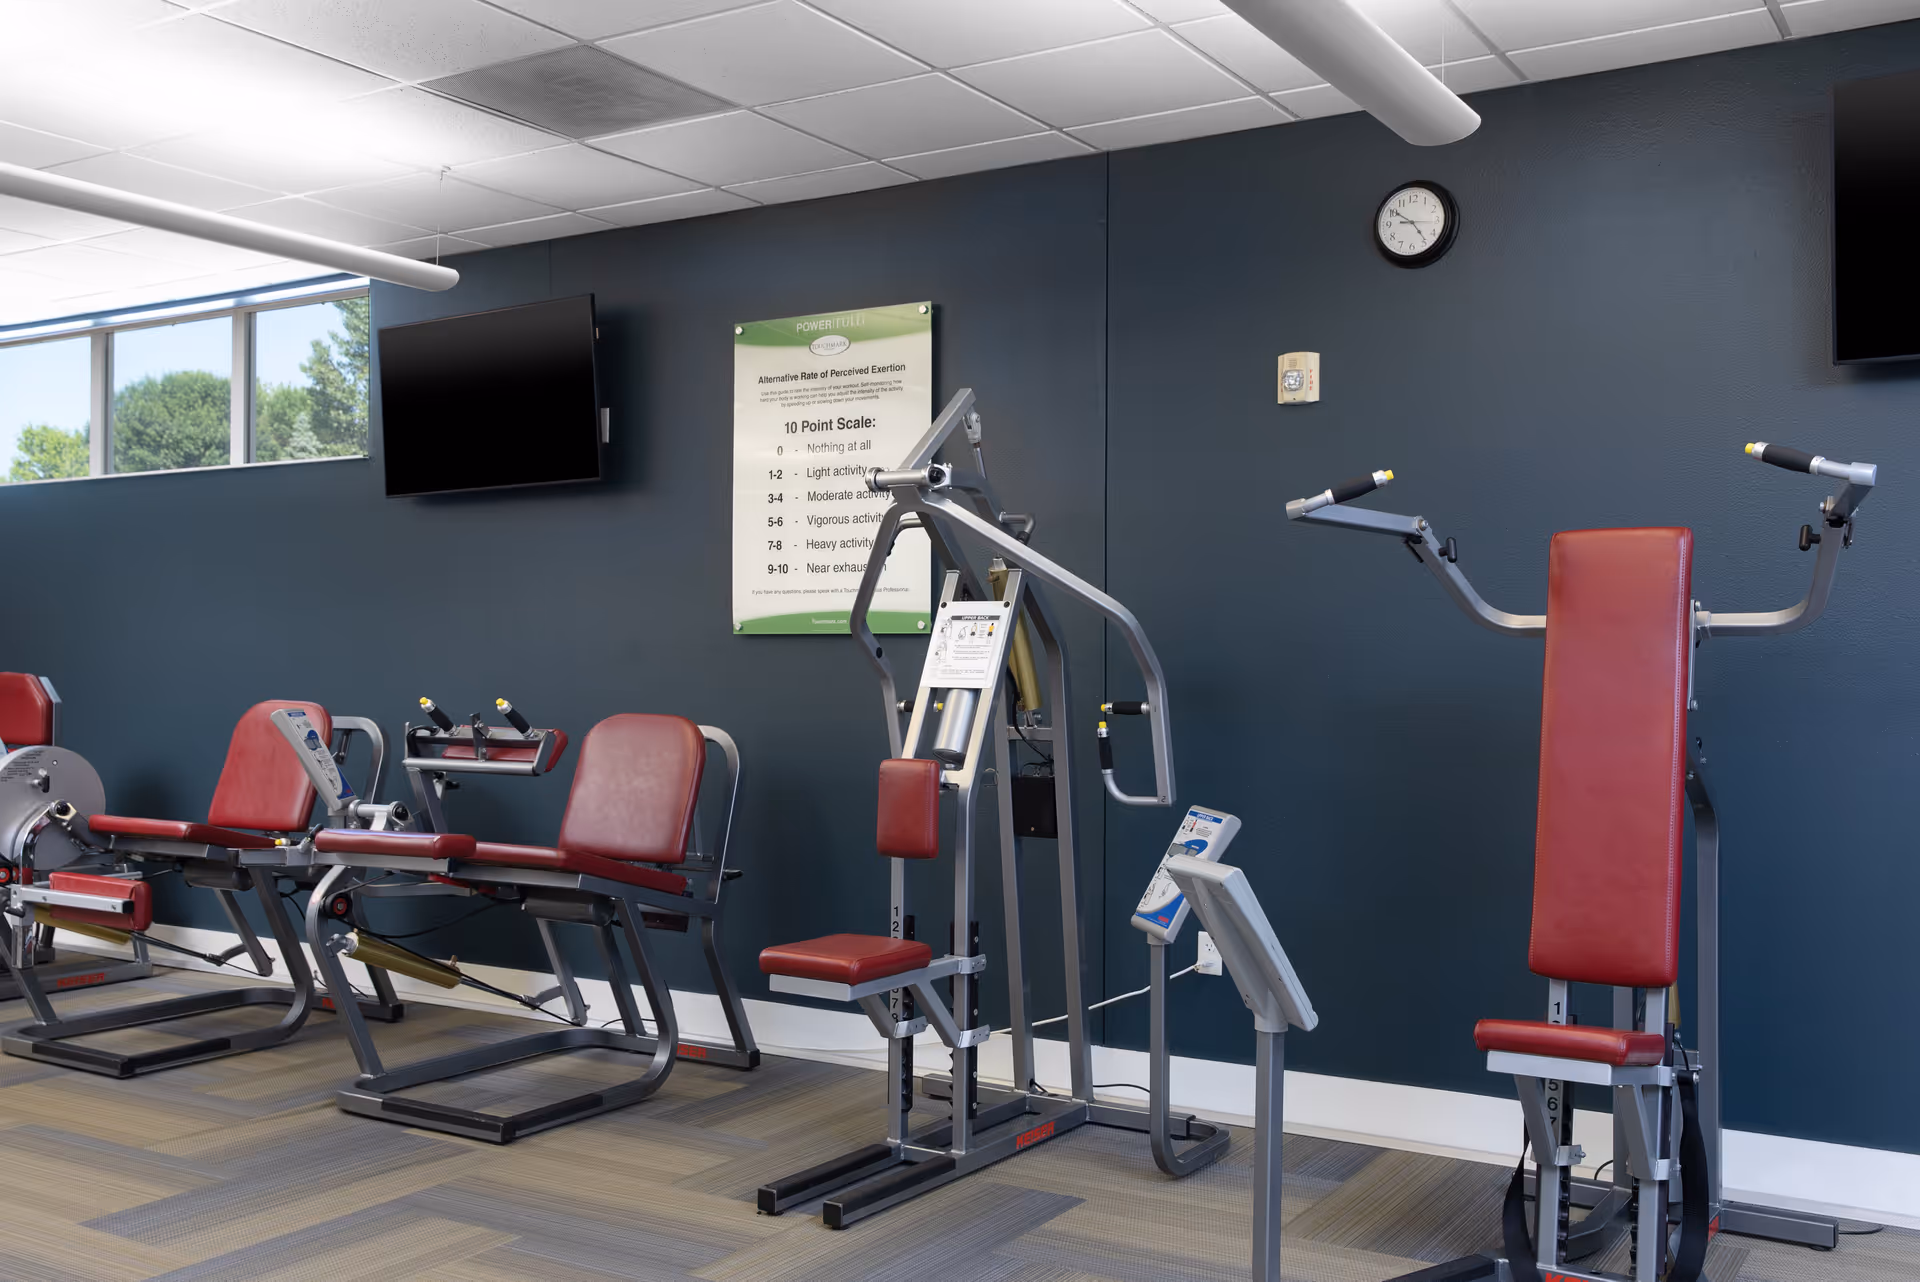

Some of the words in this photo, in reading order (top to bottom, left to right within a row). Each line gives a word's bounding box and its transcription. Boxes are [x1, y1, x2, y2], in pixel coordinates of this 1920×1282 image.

[1398, 199, 1405, 208] 11
[1409, 195, 1418, 203] 12
[1390, 208, 1398, 218] 10
[1431, 205, 1437, 214] 2
[1434, 216, 1440, 224] 3
[1390, 232, 1396, 241] 8
[1430, 228, 1436, 237] 4
[1398, 240, 1404, 248] 7
[758, 374, 798, 384] Alternative
[801, 372, 818, 380] Rate
[820, 370, 828, 378] of
[830, 366, 869, 377] Perceived
[872, 364, 906, 373] Exertion
[784, 422, 798, 434] 10
[802, 419, 834, 432] Point
[837, 416, 876, 430] Scale:
[777, 446, 783, 456] 0
[808, 442, 844, 454] Nothing
[848, 440, 856, 451] at
[860, 440, 871, 450] all
[769, 470, 782, 480] 1-2
[807, 467, 830, 480] Light
[833, 465, 867, 477] activity
[768, 493, 783, 503] 3-4
[808, 490, 853, 502] Moderate
[856, 490, 890, 500] activity
[768, 517, 783, 527] 5-6
[807, 515, 850, 528] Vigorous
[768, 540, 782, 550] 7-8
[806, 539, 837, 551] Heavy
[840, 537, 874, 550] activity
[768, 564, 788, 574] 9-10
[806, 562, 830, 574] Near
[894, 906, 899, 916] 1
[892, 921, 900, 932] 2
[892, 998, 898, 1008] 7
[1554, 1002, 1560, 1015] 1
[676, 1044, 706, 1058] ISER
[1548, 1079, 1558, 1092] 5
[1548, 1097, 1558, 1111] 6
[1016, 1120, 1056, 1150] KEISER
